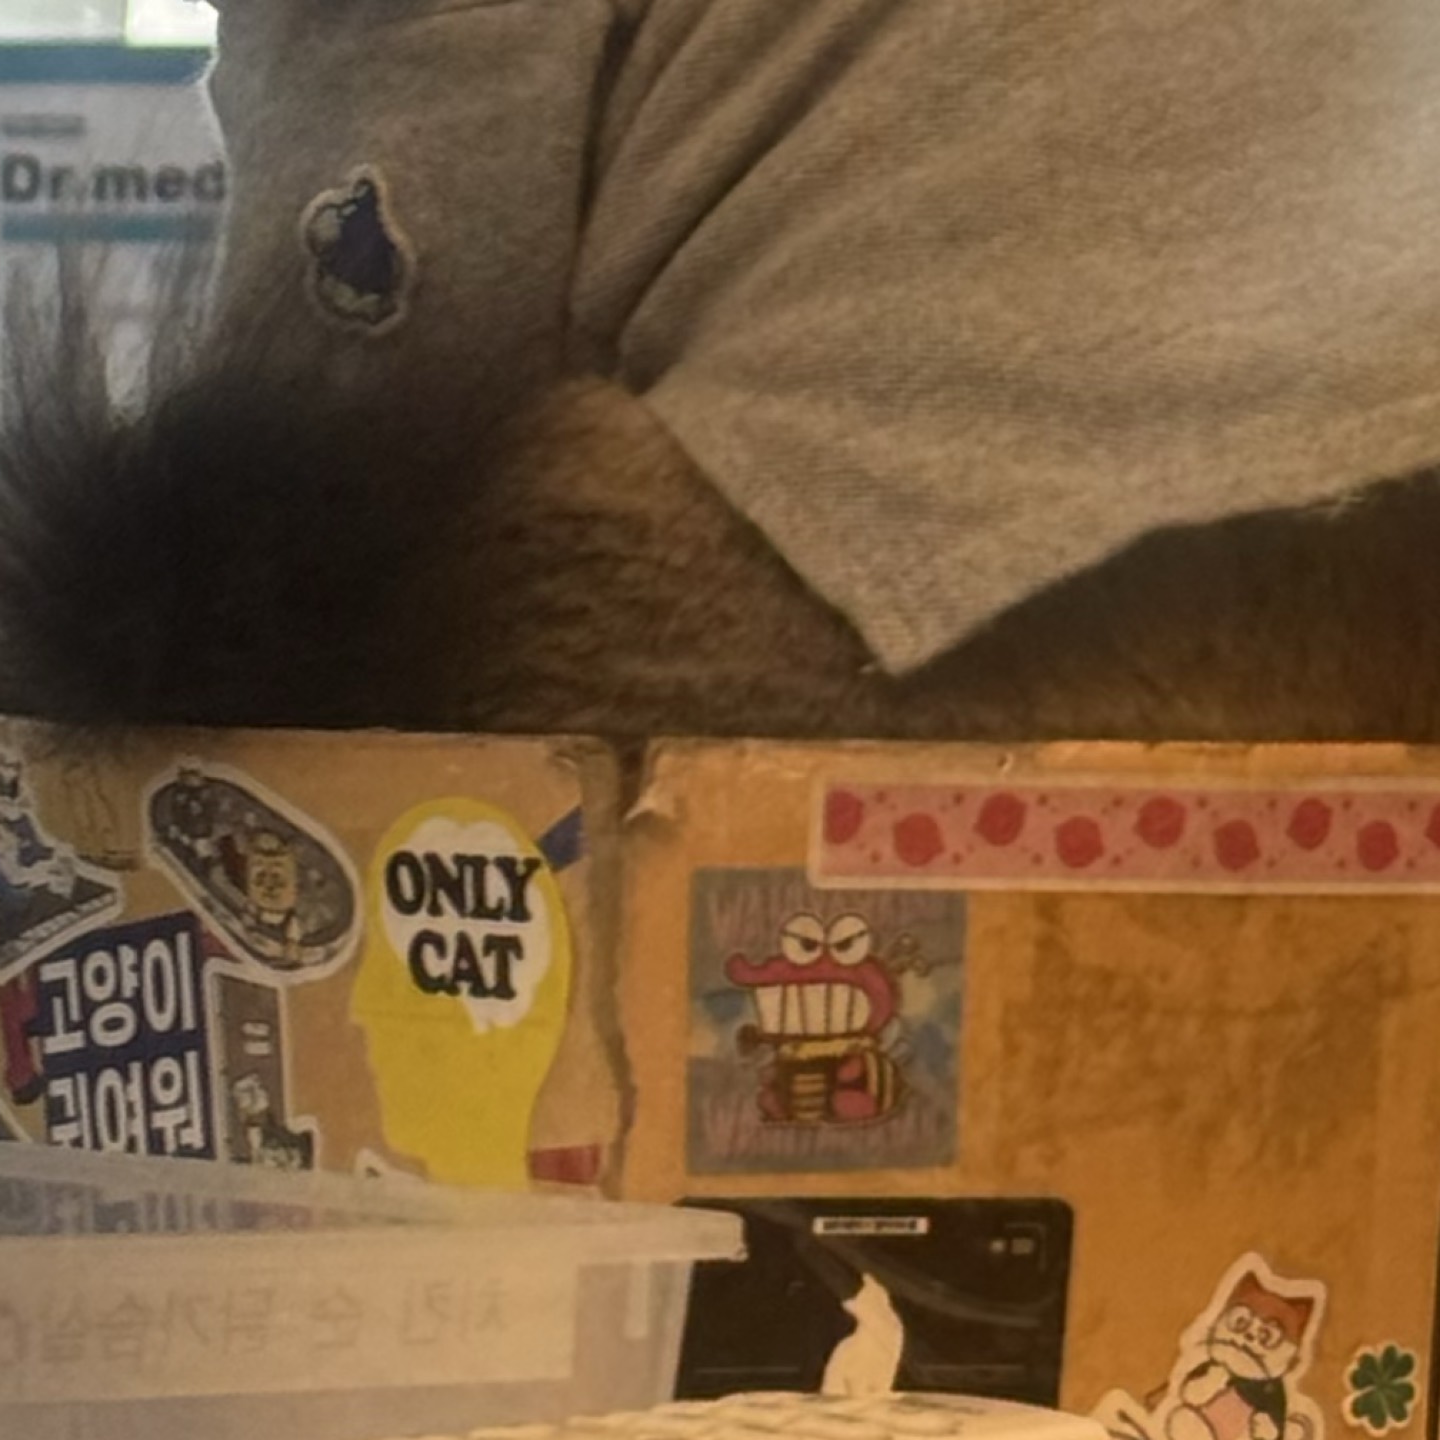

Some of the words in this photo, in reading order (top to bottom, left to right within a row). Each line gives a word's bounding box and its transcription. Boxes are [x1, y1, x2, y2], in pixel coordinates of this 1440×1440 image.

[385, 849, 542, 923] ONLY
[39, 931, 198, 1054] 고양이
[407, 928, 525, 1001] CAT
